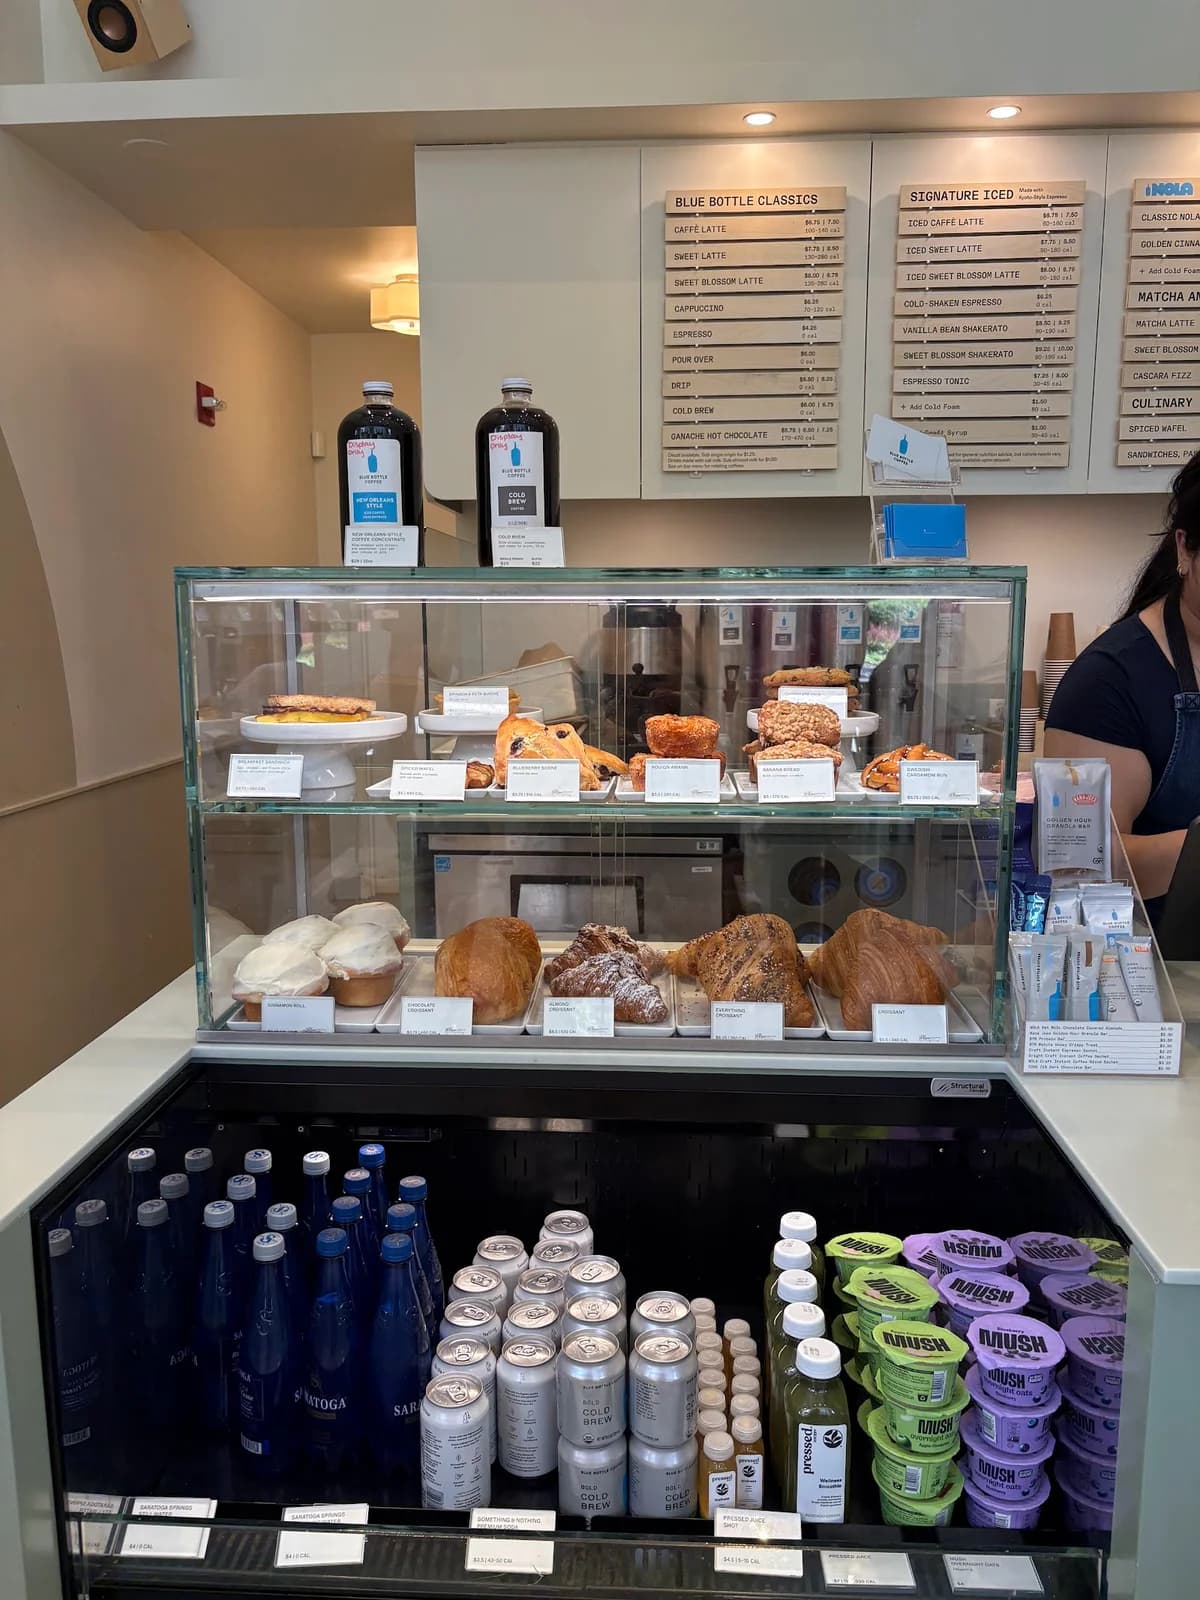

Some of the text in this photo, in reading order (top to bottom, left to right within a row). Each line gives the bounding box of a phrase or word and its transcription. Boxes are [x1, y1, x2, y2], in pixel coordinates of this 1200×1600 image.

[1152, 182, 1194, 196] NOLA
[911, 190, 1014, 201] SIGNATURE ICED
[675, 195, 818, 207] BLUE BOTTLE CLASSICS
[1142, 213, 1178, 221] CLASSIC
[908, 219, 928, 227] ICED
[958, 218, 985, 226] LATTE
[702, 225, 726, 233] LATTE
[1141, 240, 1172, 248] GOLDEN
[929, 246, 955, 254] SWEET
[956, 245, 983, 253] LATTE
[674, 252, 726, 261] SWEET LATTE
[906, 273, 926, 281] ICED
[957, 272, 992, 280] BLOSSOM
[994, 271, 1020, 279] LATTE
[675, 277, 763, 287] SWEET BLOSSOM LATTE
[1138, 292, 1184, 302] MATCHA
[904, 298, 1002, 308] COLD-SHAKEN ESPRESSO
[1136, 320, 1166, 328] MATCHA
[903, 324, 1008, 334] VANILLA BEAN SHAKERATO
[673, 330, 712, 338] ESPRESSO
[1135, 346, 1160, 354] SWEET
[672, 355, 714, 364] POUR OVER
[903, 350, 1014, 360] SWEET BLOSSOM SHAKERATO
[1133, 372, 1169, 380] CASCARA
[903, 377, 970, 385] ESPRESSO TONIC
[672, 382, 691, 390] DRIP
[1132, 398, 1192, 409] CULINARY
[673, 407, 693, 415] COLD
[947, 429, 968, 437] Syrup
[1129, 424, 1187, 433] SPICED WAFEL
[707, 432, 721, 440] HOT
[724, 431, 768, 439] CHOCOLATE
[1127, 451, 1181, 459] SANDWICHES,
[836, 1237, 890, 1255] MUSH
[949, 1278, 1014, 1303] MUSH
[882, 1331, 952, 1352] MUSH
[979, 1328, 1048, 1353] MUSH
[987, 1368, 1026, 1390] MUSH
[582, 1406, 610, 1416] COLD
[583, 1415, 612, 1425] BREW
[917, 1418, 953, 1434] MUSH
[801, 1427, 815, 1475] pressed
[978, 1458, 1015, 1483] MUSH
[580, 1493, 608, 1501] COLD
[665, 1489, 690, 1502] COLD
[581, 1502, 611, 1510] BREW
[723, 1515, 749, 1523] PRESSED
